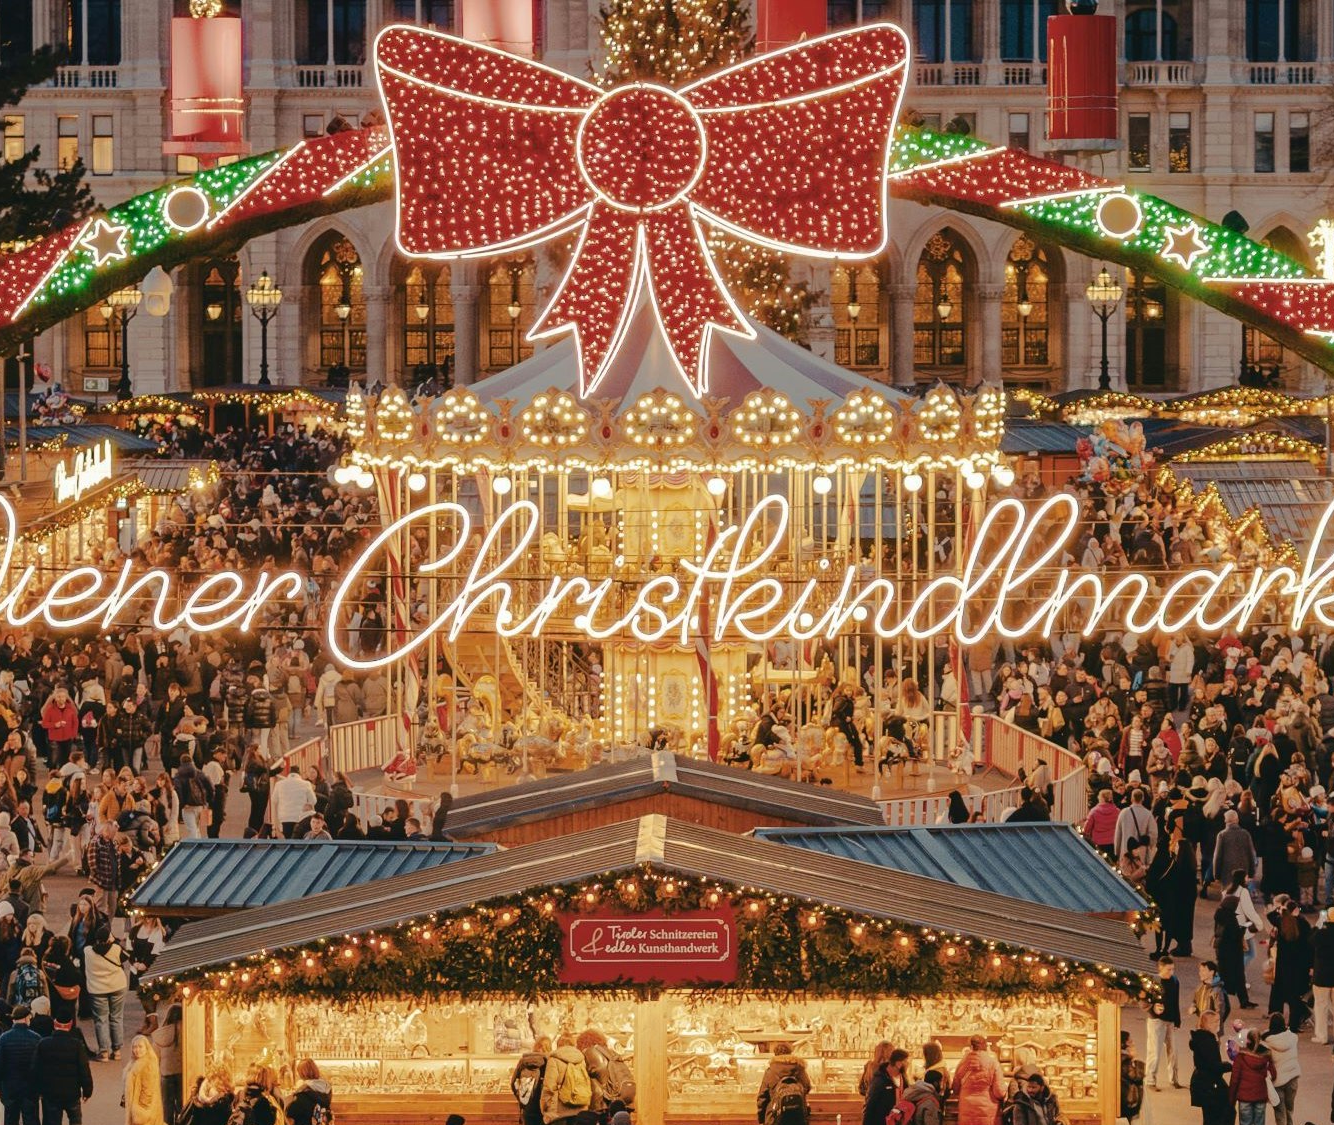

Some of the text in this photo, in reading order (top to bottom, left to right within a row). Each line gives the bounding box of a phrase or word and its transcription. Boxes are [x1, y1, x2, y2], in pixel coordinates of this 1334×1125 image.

[607, 925, 718, 940] Tiroler Schnitzereien
[605, 941, 637, 954] edles
[638, 943, 719, 954] Kunsthandwerk
